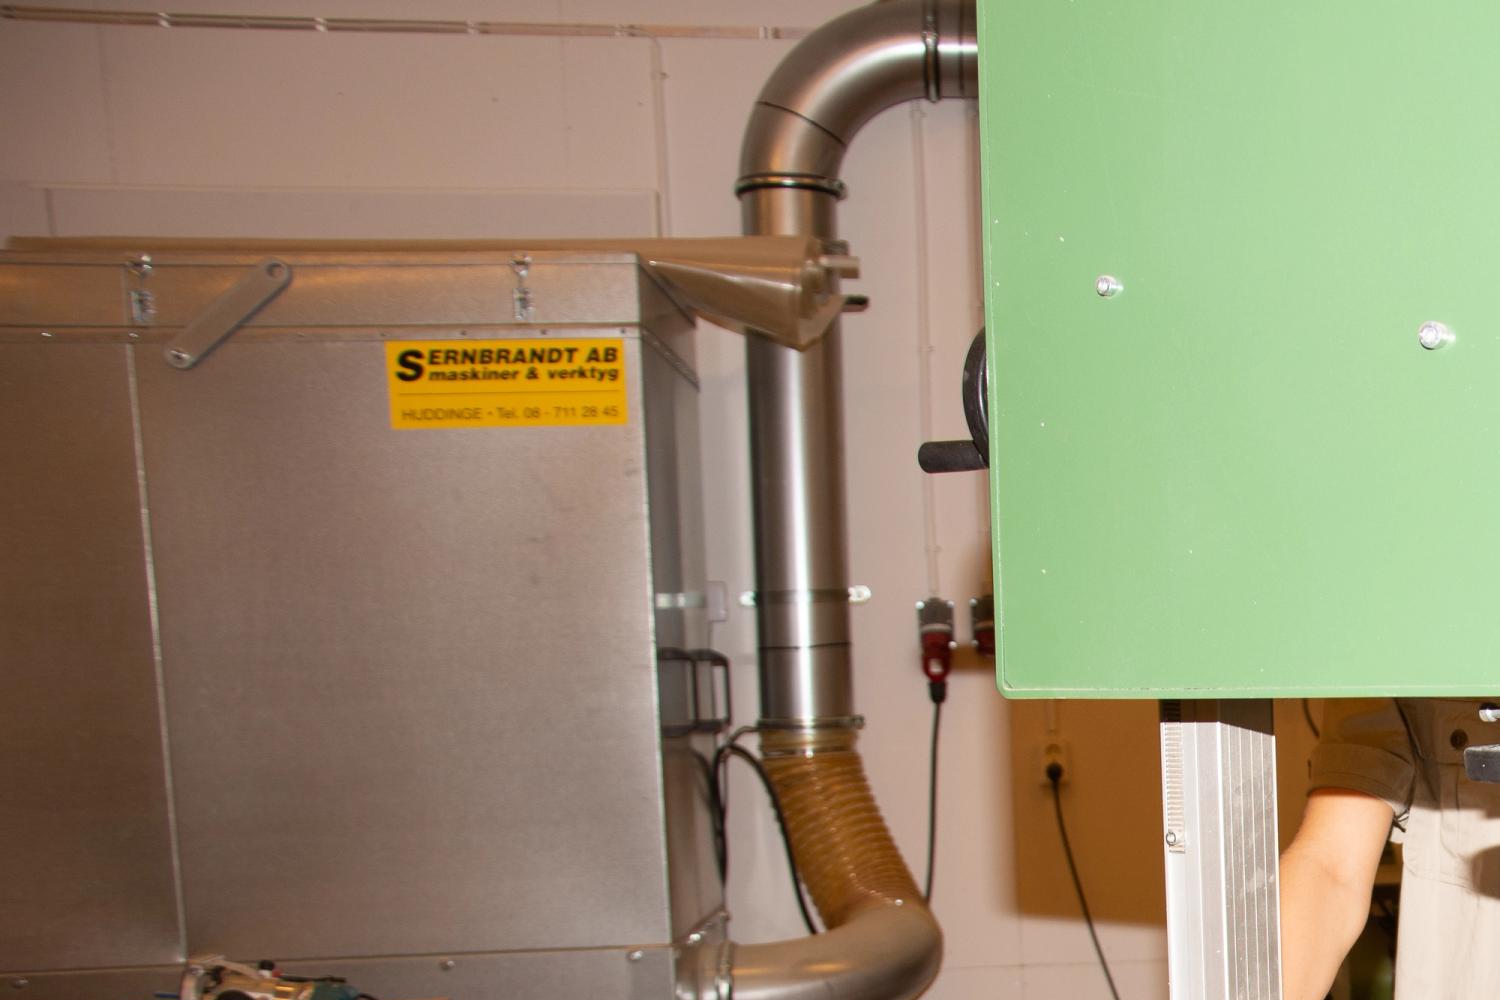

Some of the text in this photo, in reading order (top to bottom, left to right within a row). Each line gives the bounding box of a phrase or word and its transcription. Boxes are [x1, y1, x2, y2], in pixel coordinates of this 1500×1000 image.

[396, 347, 618, 382] SERNBRANDT AB
[428, 365, 620, 382] maskiner & verktyg
[401, 406, 482, 421] HUDDINGE
[497, 406, 518, 419] Tel.
[554, 405, 576, 418] 711
